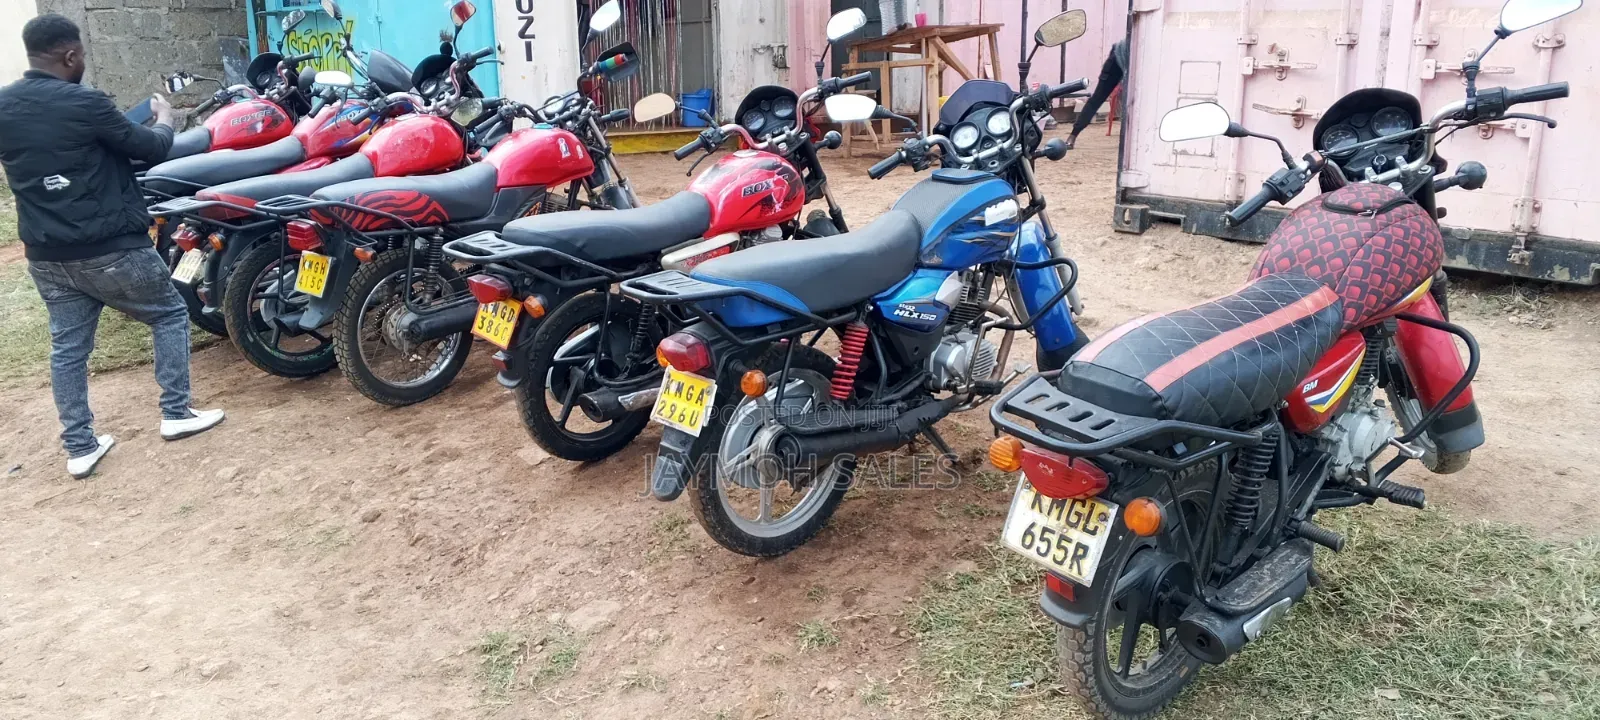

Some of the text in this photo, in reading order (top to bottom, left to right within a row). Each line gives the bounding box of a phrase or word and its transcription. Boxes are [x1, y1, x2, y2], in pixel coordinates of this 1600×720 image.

[231, 109, 273, 127] BOXER
[298, 274, 323, 291] 415C
[477, 315, 508, 341] 386C
[893, 309, 937, 321] HLX 150
[663, 378, 705, 406] KMGA
[656, 400, 700, 427] 296U
[1031, 493, 1099, 536] KMGL
[1021, 521, 1089, 576] 655R
